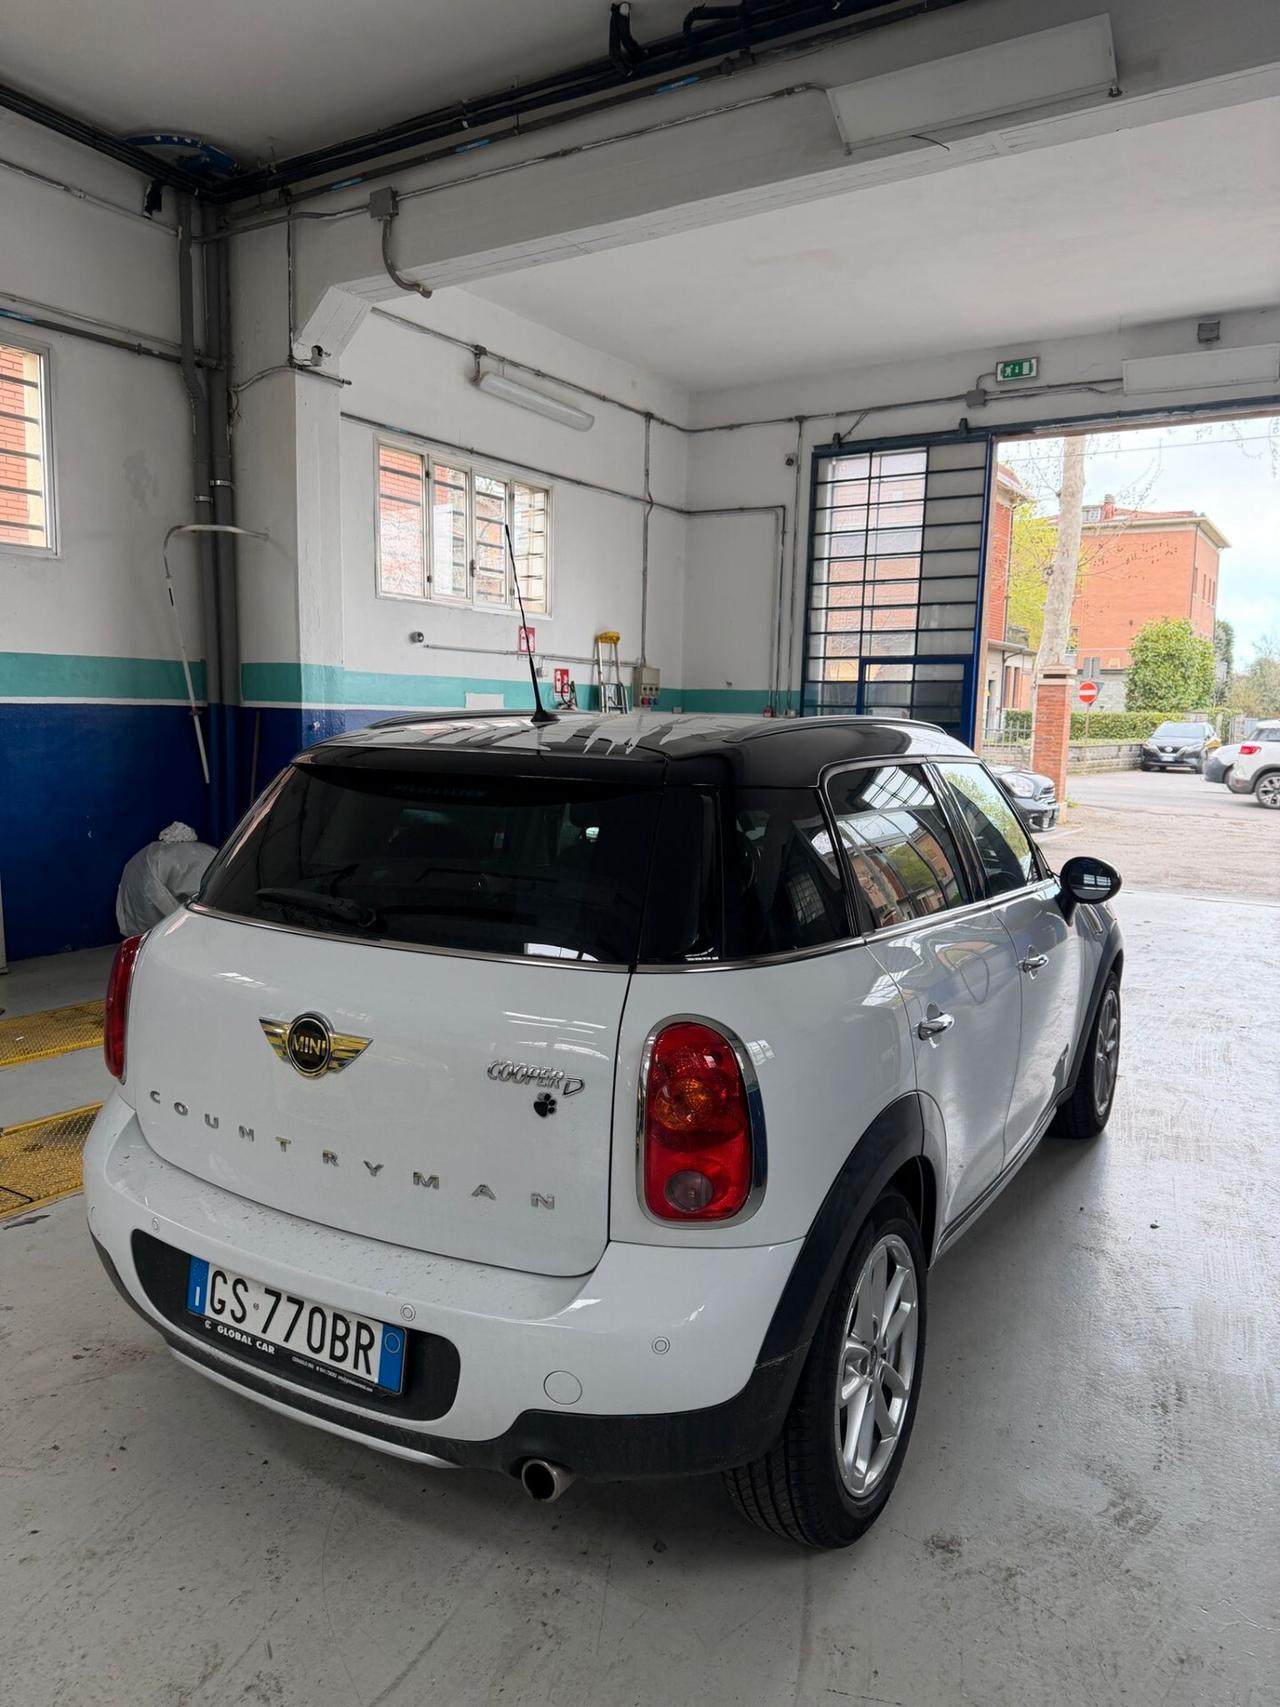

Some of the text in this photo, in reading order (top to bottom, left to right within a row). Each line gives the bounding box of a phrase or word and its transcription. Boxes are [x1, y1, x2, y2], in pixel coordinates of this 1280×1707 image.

[292, 1034, 326, 1056] MINI
[487, 1060, 585, 1098] COOPER D
[149, 1090, 556, 1210] COUNTRYMAN
[210, 1270, 249, 1323] GS
[261, 1287, 375, 1376] 770BR
[217, 1325, 275, 1355] GLOBAL CAR
